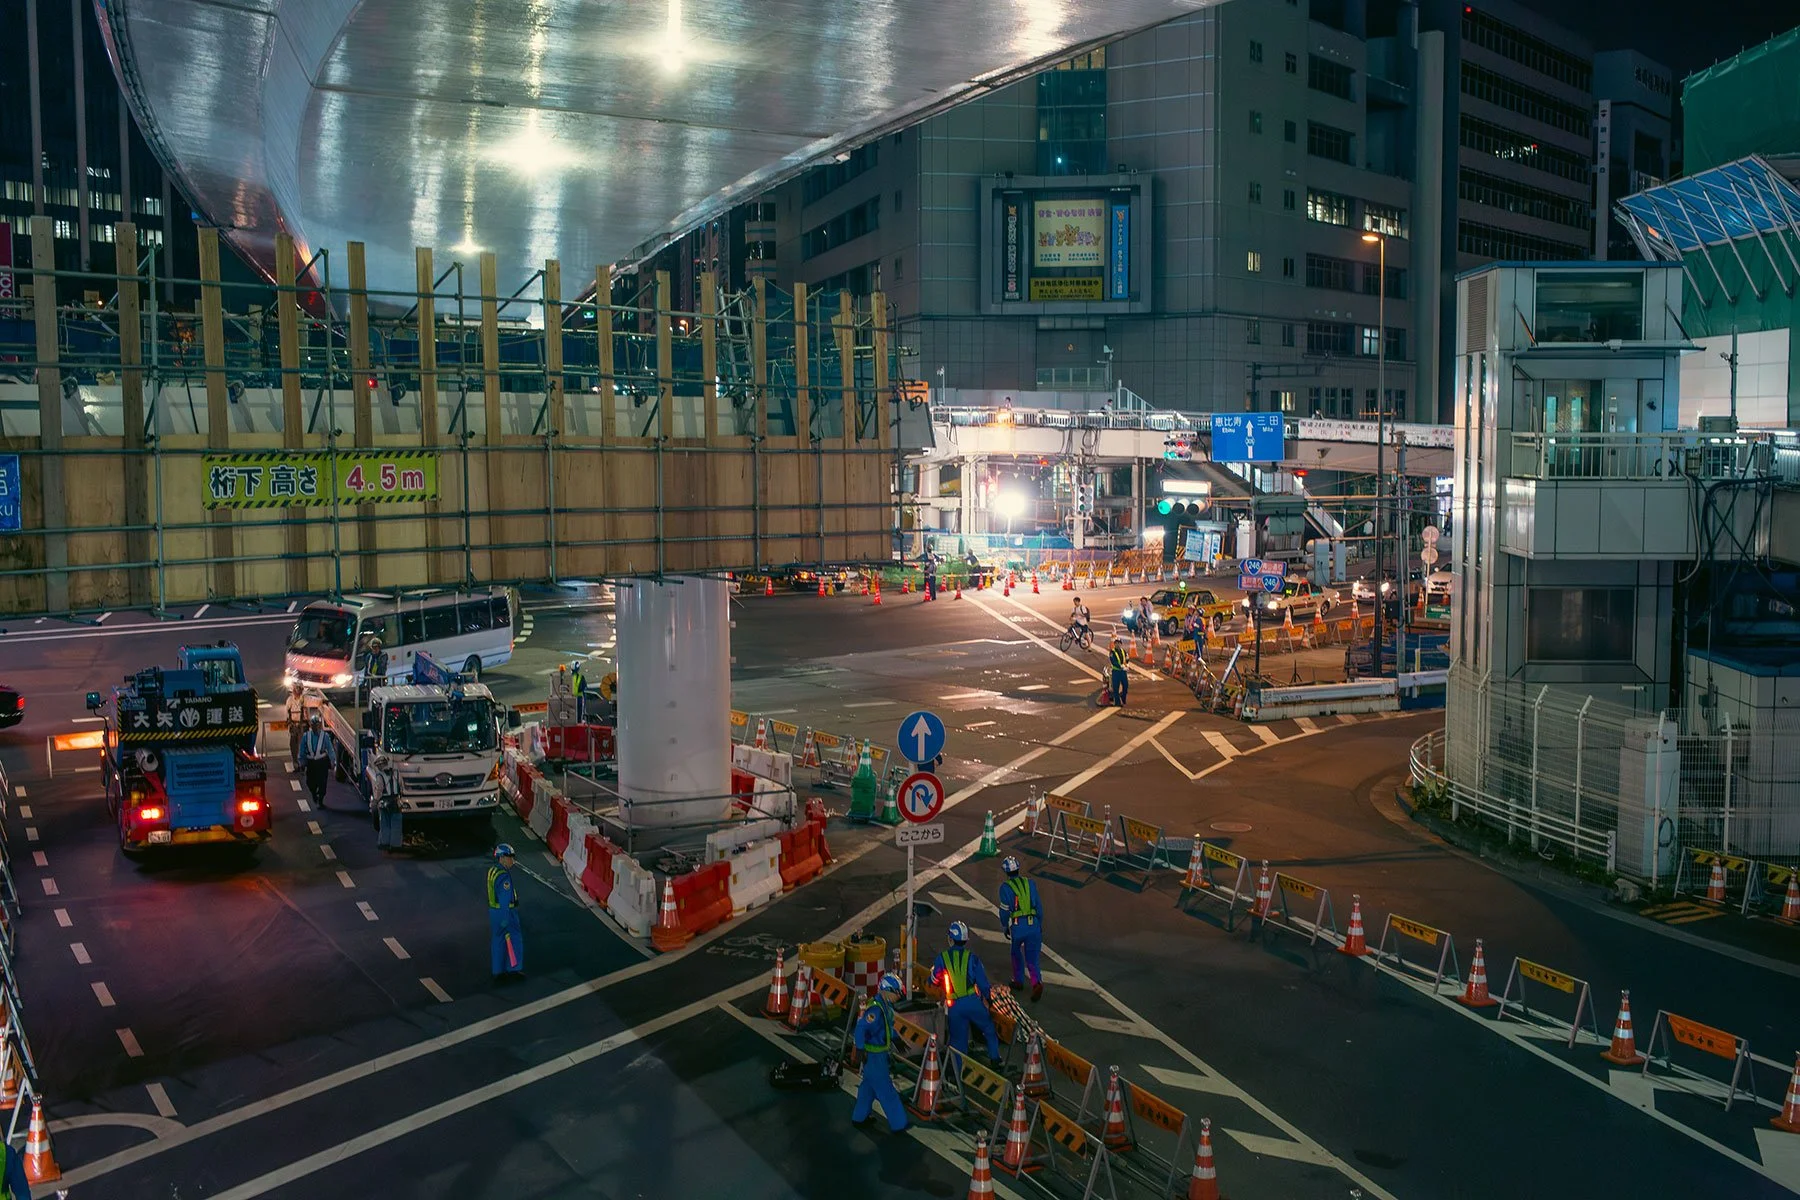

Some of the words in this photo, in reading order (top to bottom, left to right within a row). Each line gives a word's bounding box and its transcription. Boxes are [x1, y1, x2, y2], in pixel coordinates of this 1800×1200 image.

[1214, 416, 1242, 427] 恵比寿
[1257, 415, 1279, 426] 三田
[210, 465, 318, 499] 桁下高さ
[346, 463, 425, 492] 4.5m
[1248, 561, 1260, 570] 246
[1264, 577, 1276, 586] 246
[134, 712, 173, 728] 大矢
[207, 707, 243, 725] 運送
[900, 829, 941, 842] ここから
